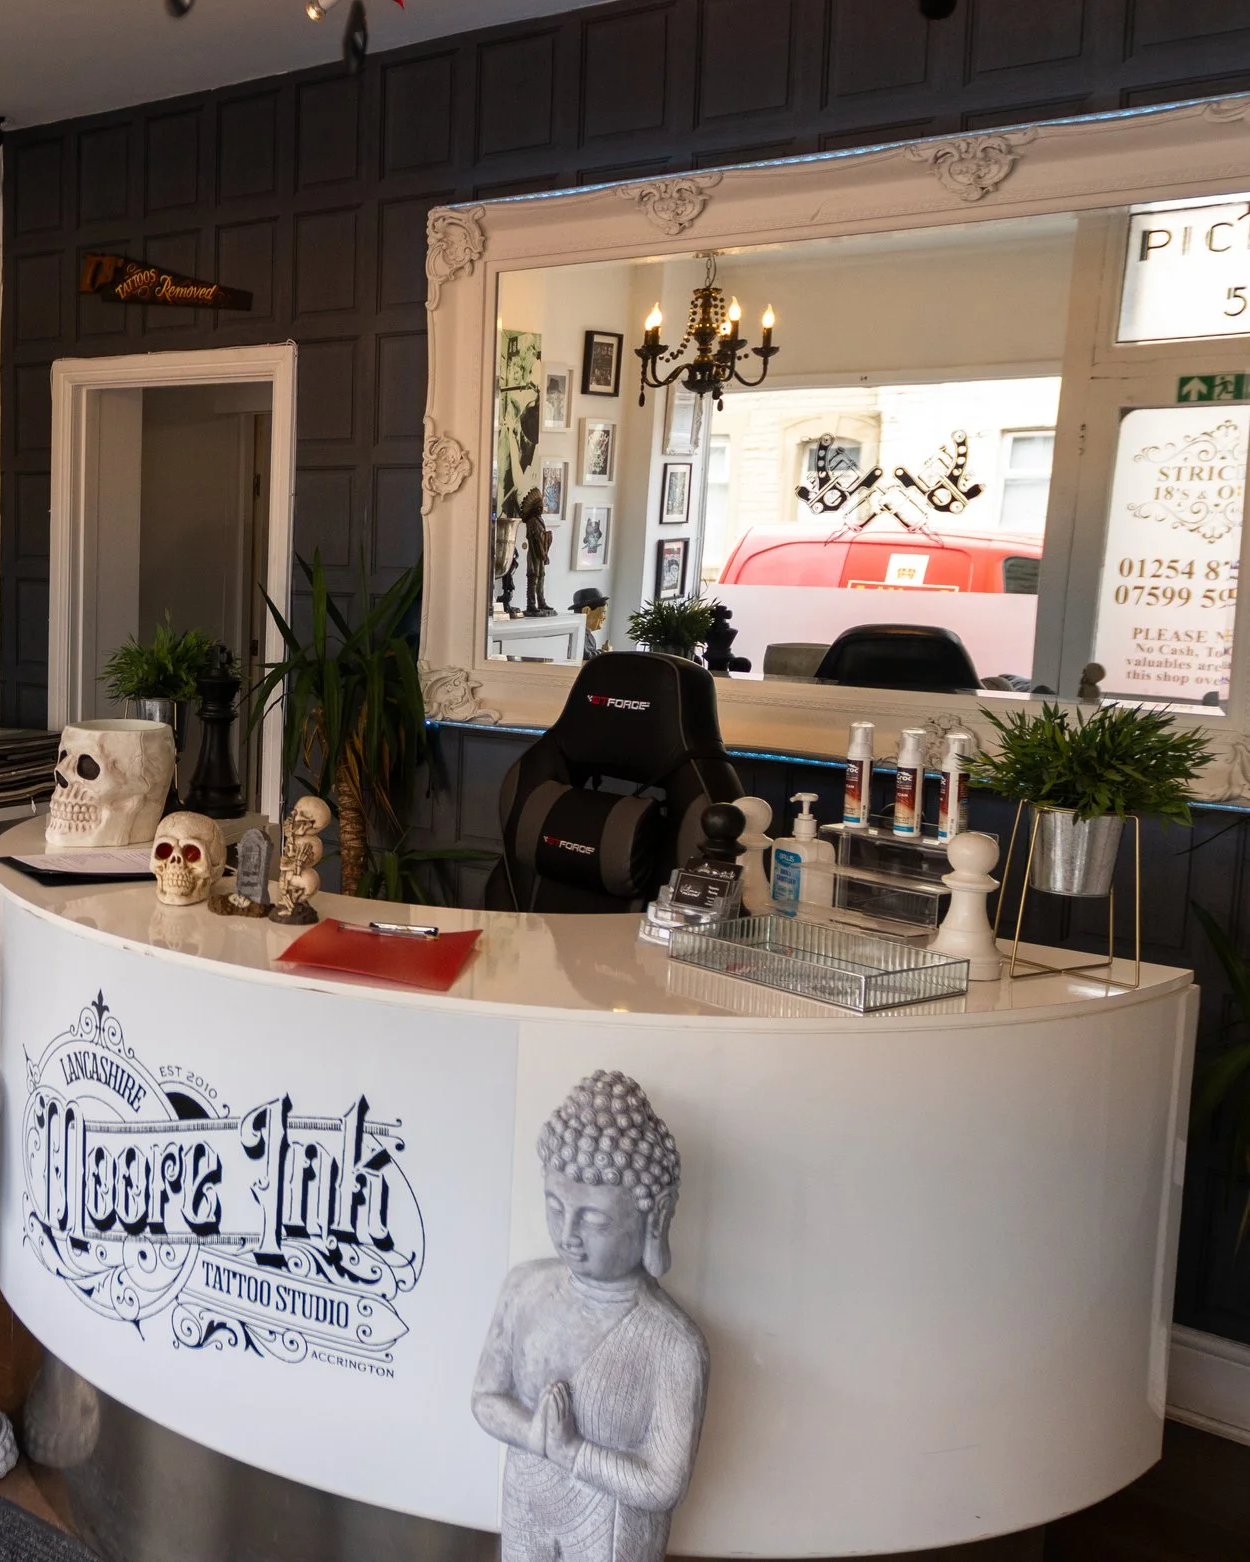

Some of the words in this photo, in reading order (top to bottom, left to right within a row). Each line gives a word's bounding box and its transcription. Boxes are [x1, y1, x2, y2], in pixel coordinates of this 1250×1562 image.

[115, 268, 156, 300] TATTOOS
[155, 274, 217, 302] Removed
[1119, 557, 1195, 580] 01254
[1114, 584, 1192, 607] 07599
[1132, 627, 1208, 643] PLEASE
[1135, 643, 1154, 654] No
[1125, 655, 1192, 671] valuables
[1125, 670, 1152, 682] this
[1155, 671, 1190, 686] shop
[59, 1051, 147, 1113] LANCASHIRE
[159, 1065, 183, 1078] EST
[186, 1071, 218, 1099] 2010
[34, 1095, 223, 1251] Moore
[240, 1092, 396, 1269] Ink
[201, 1260, 272, 1308] TATTOO
[275, 1285, 350, 1330] STUDIO
[311, 1350, 395, 1379] ACCRINGTON
